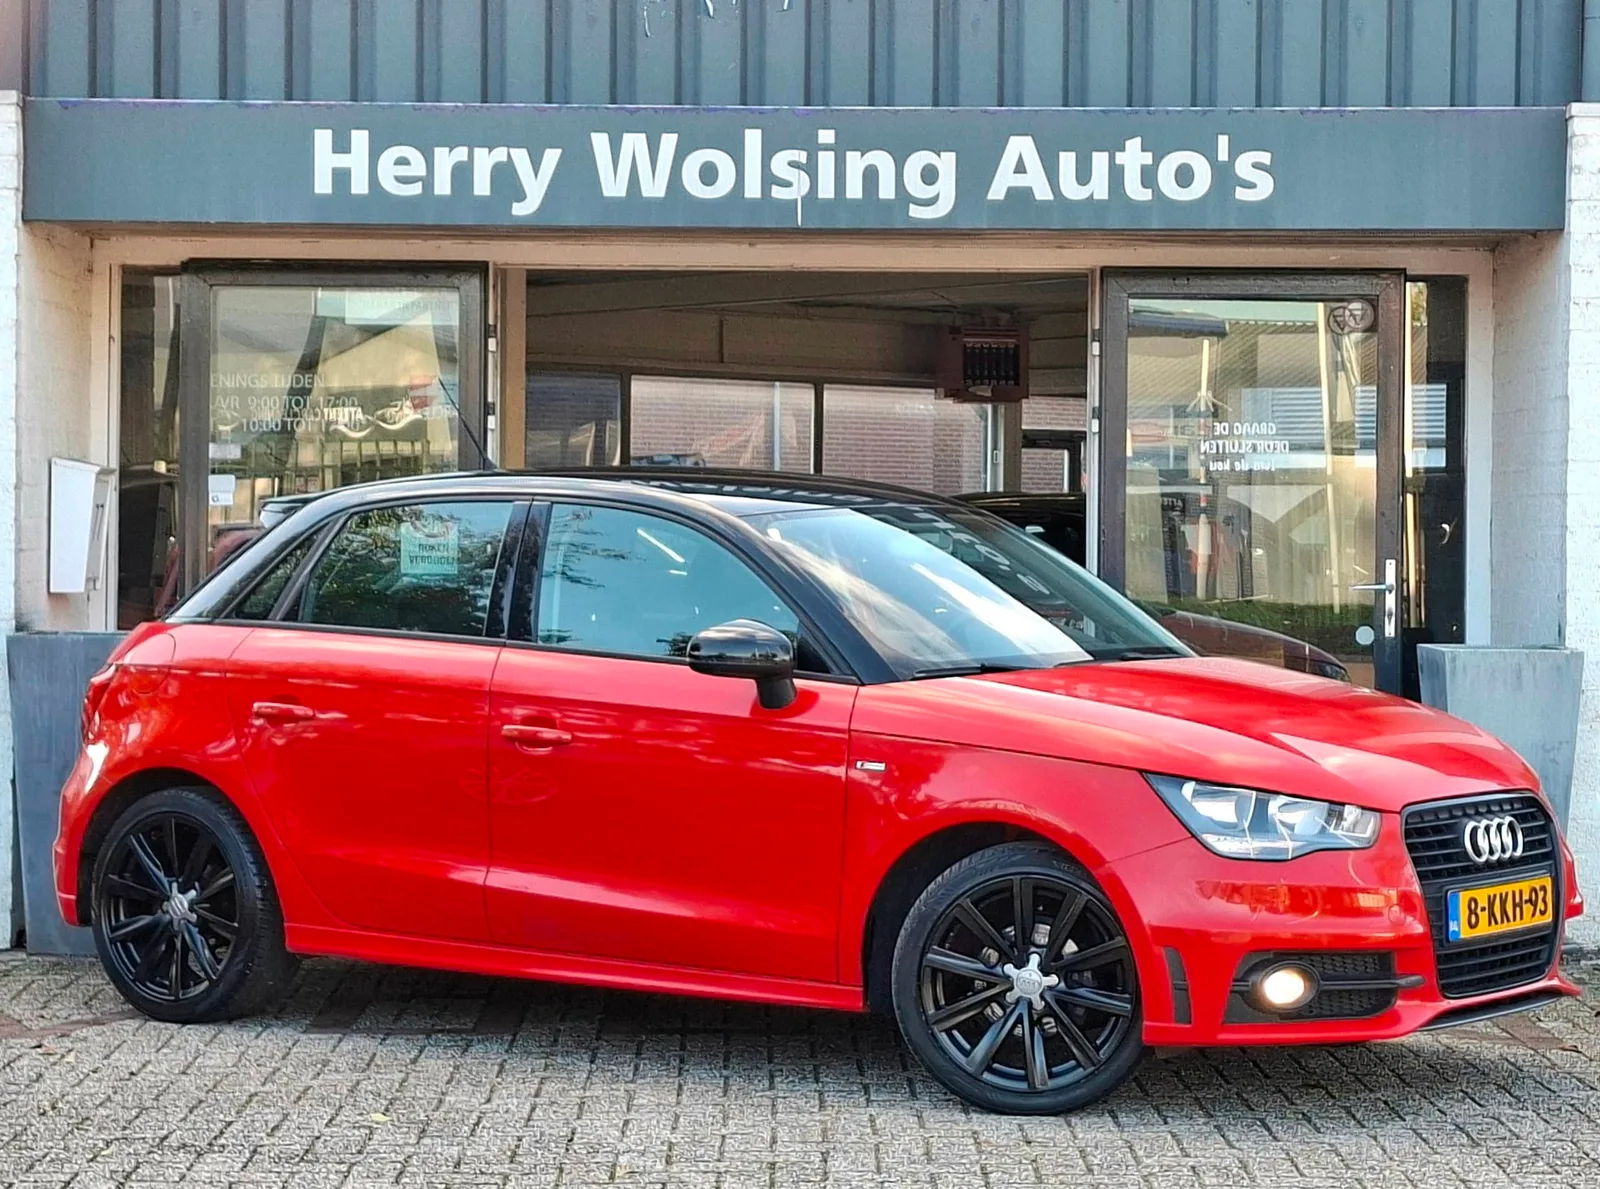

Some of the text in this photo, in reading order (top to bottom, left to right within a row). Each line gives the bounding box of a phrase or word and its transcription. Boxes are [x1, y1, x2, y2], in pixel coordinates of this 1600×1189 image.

[313, 128, 1275, 219] Herry Wolsing Auto's
[1467, 884, 1548, 930] 8-KKH-93
